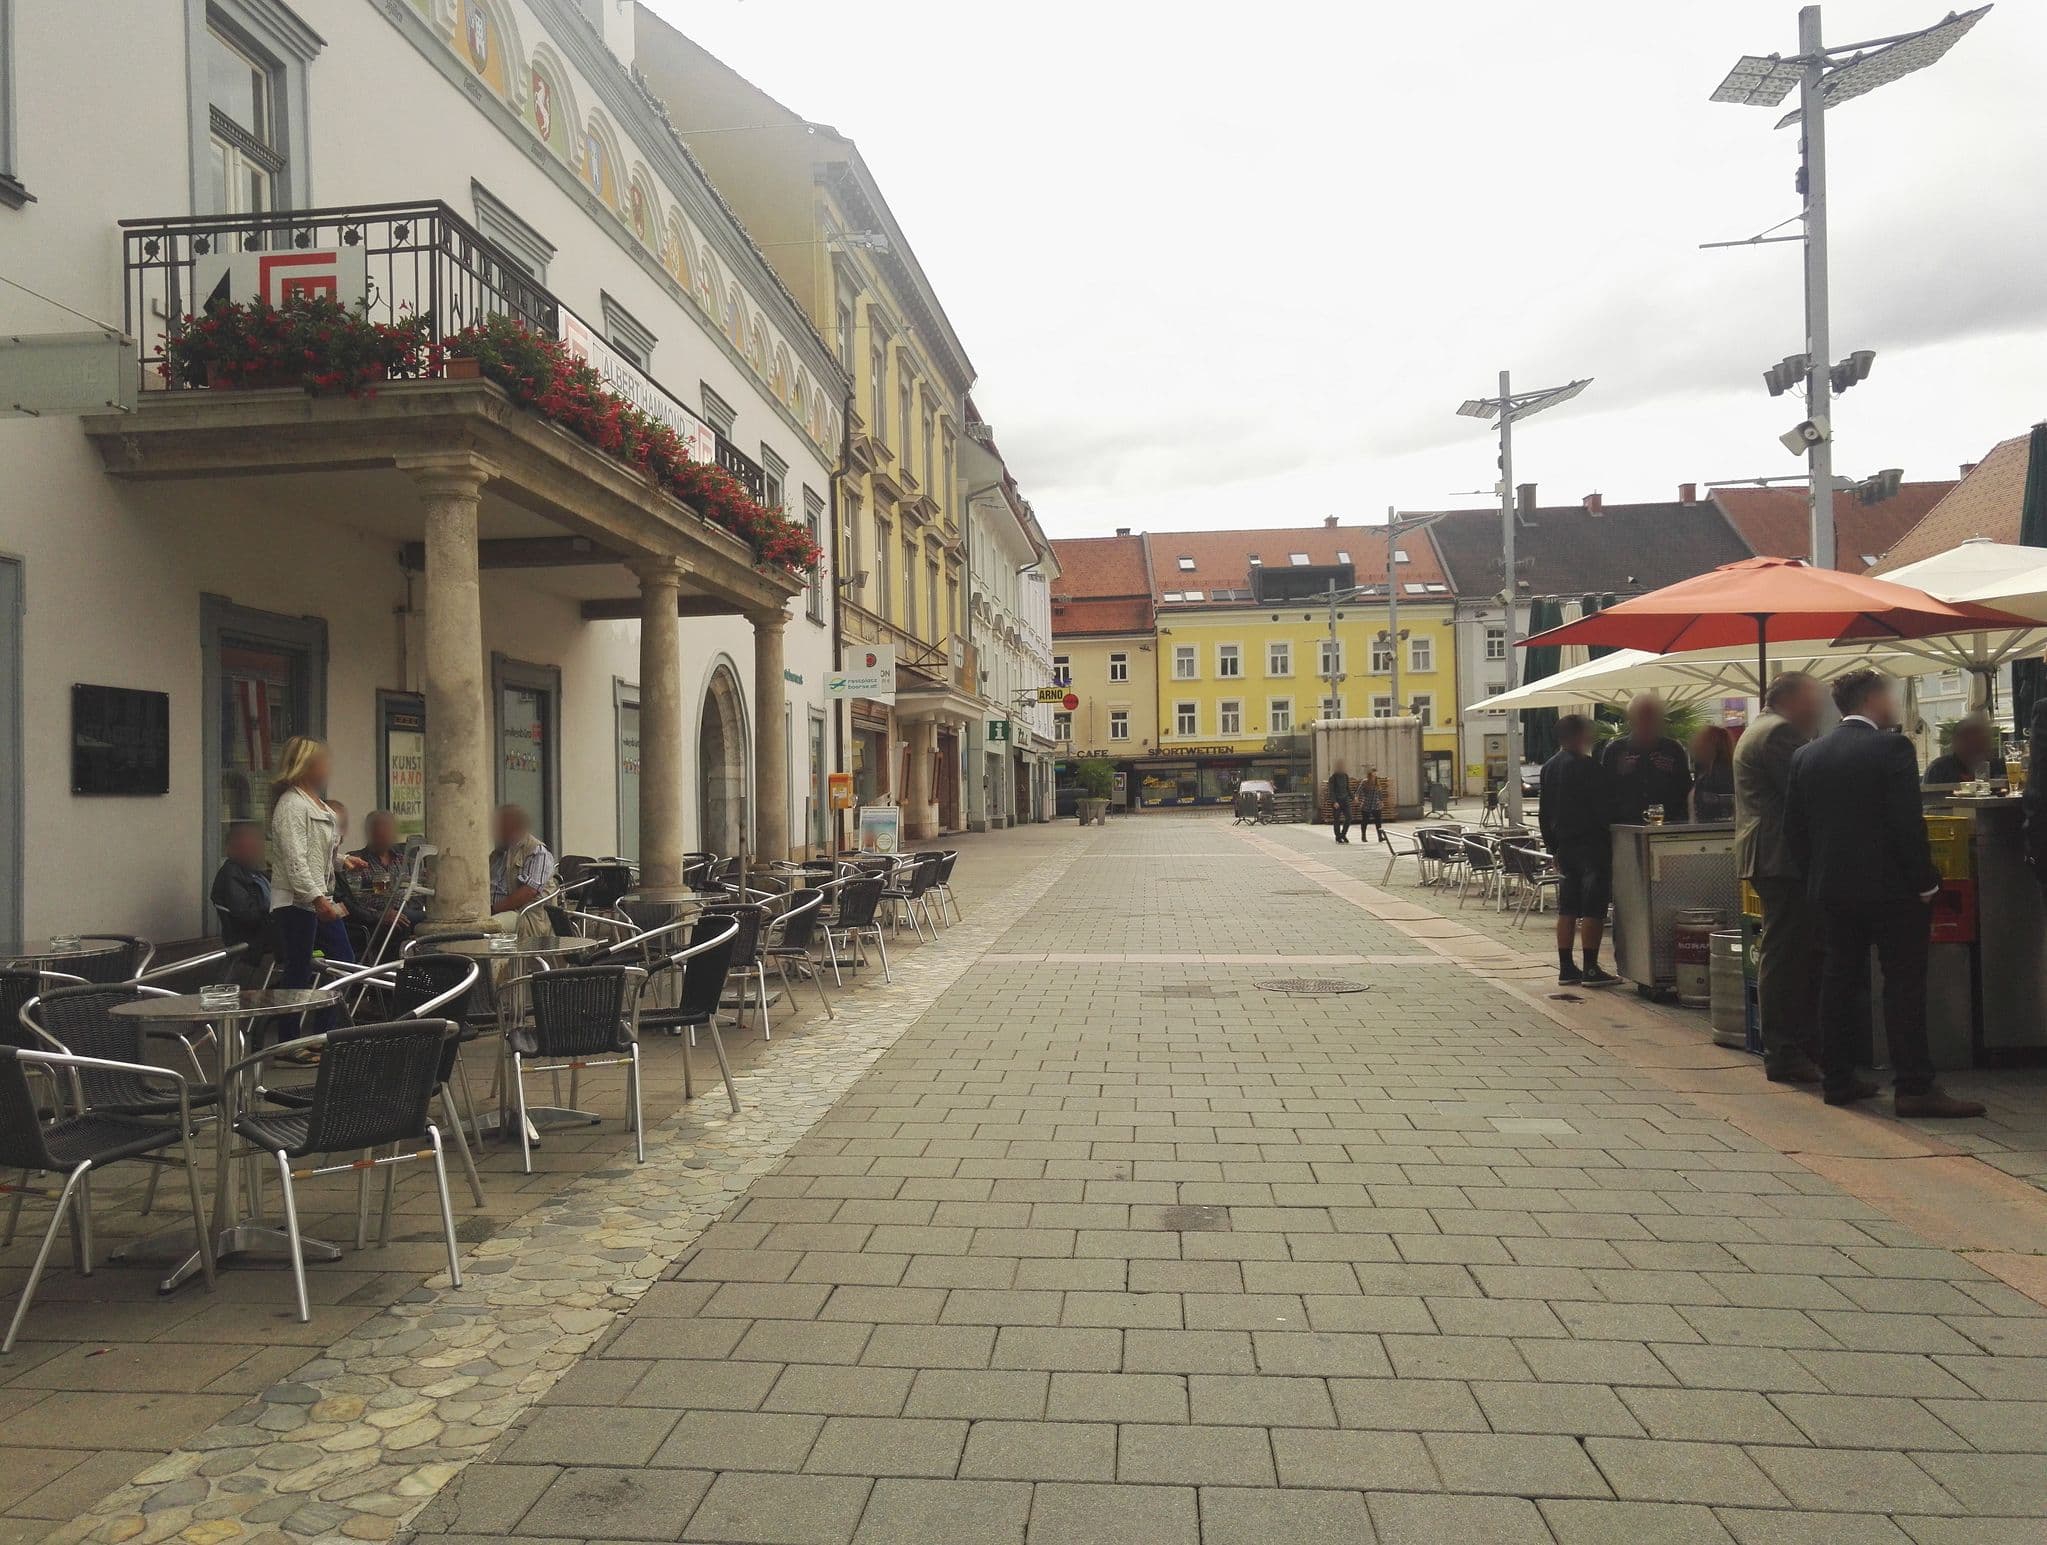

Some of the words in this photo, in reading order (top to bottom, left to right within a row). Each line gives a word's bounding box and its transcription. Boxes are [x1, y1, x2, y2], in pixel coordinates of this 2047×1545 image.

[603, 356, 641, 404] ALBERT
[642, 388, 685, 436] HAMMOND
[1039, 689, 1063, 700] ARNO
[1148, 745, 1234, 756] SPORTWETTEN
[392, 755, 421, 770] KUNST
[392, 771, 422, 785] HAND
[392, 787, 421, 801] WERKS
[392, 801, 421, 816] MARKT
